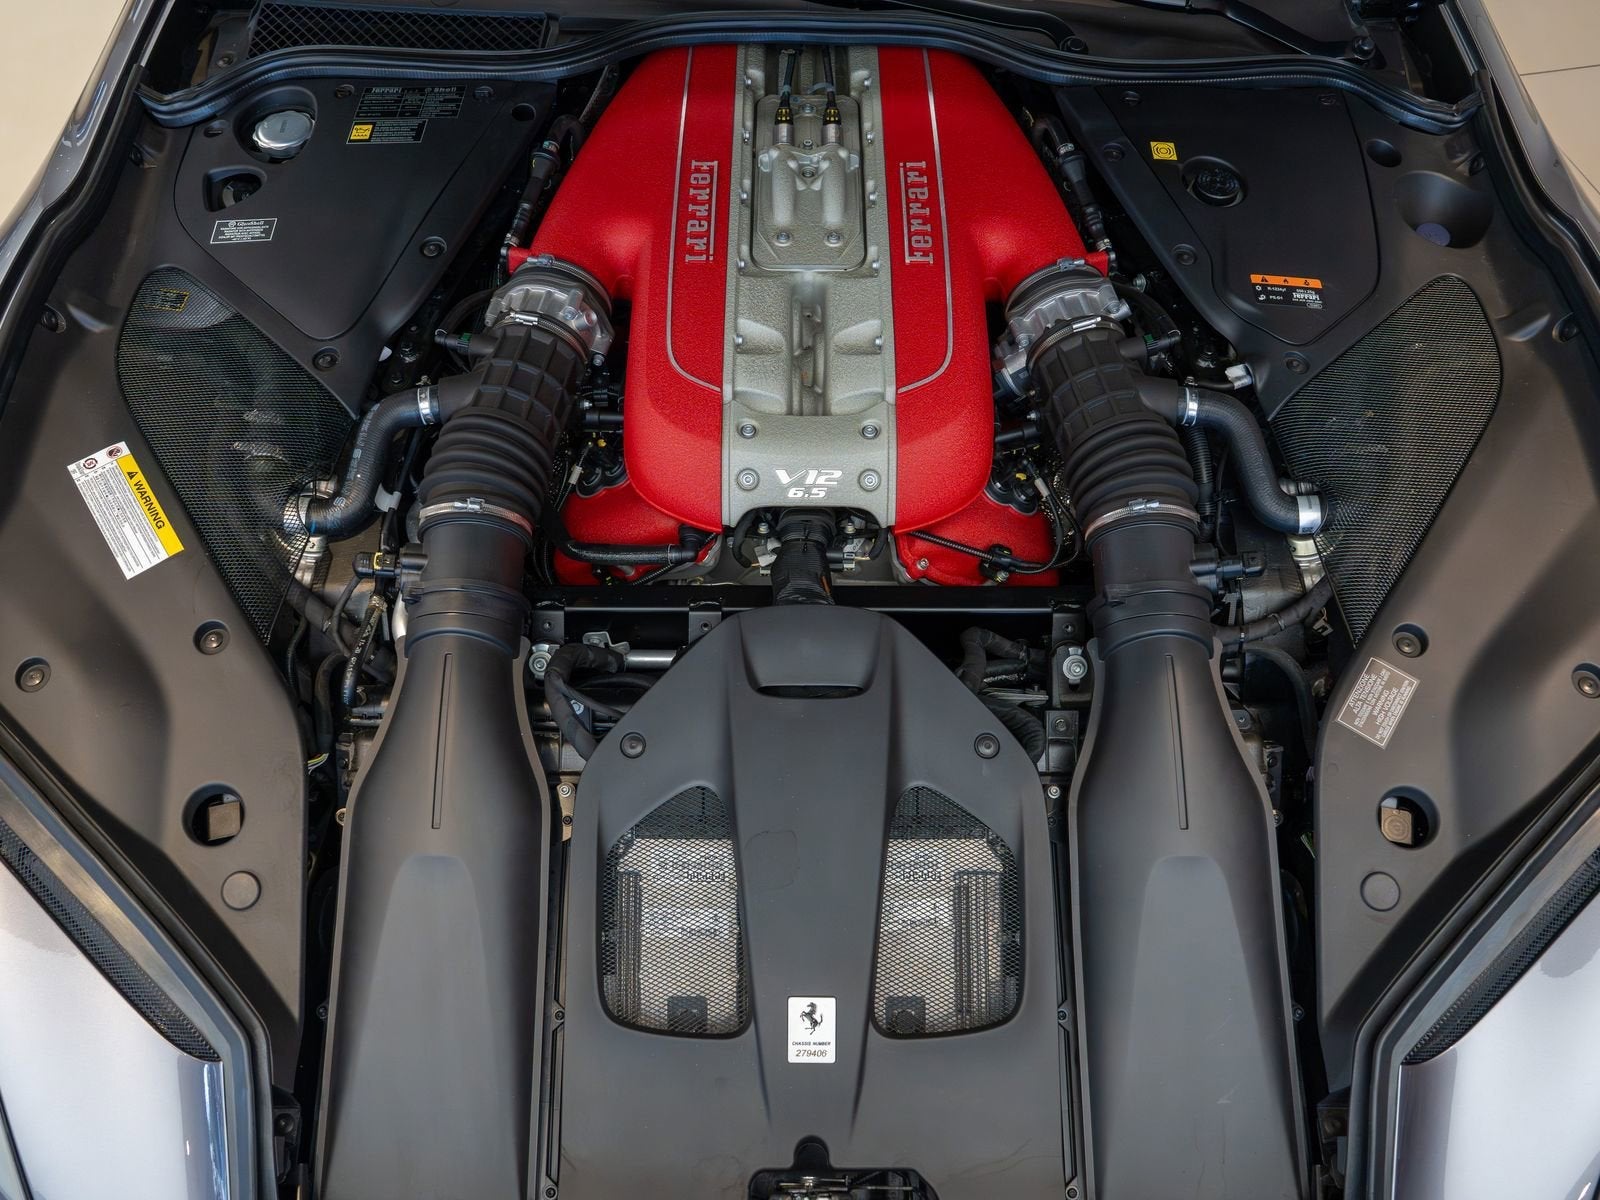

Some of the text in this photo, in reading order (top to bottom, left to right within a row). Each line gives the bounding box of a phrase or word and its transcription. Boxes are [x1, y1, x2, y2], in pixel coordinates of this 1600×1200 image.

[685, 160, 718, 263] Ferrari
[899, 161, 934, 264] Ferrari
[775, 469, 842, 485] V12
[134, 480, 165, 530] WARNING
[787, 487, 828, 498] 6.5
[1348, 673, 1371, 708] ATTENZIONE
[1371, 689, 1390, 716] WARNING
[1382, 687, 1399, 711] VOLTAGE
[1352, 700, 1364, 714] ALTA
[795, 1049, 827, 1057] 279406
